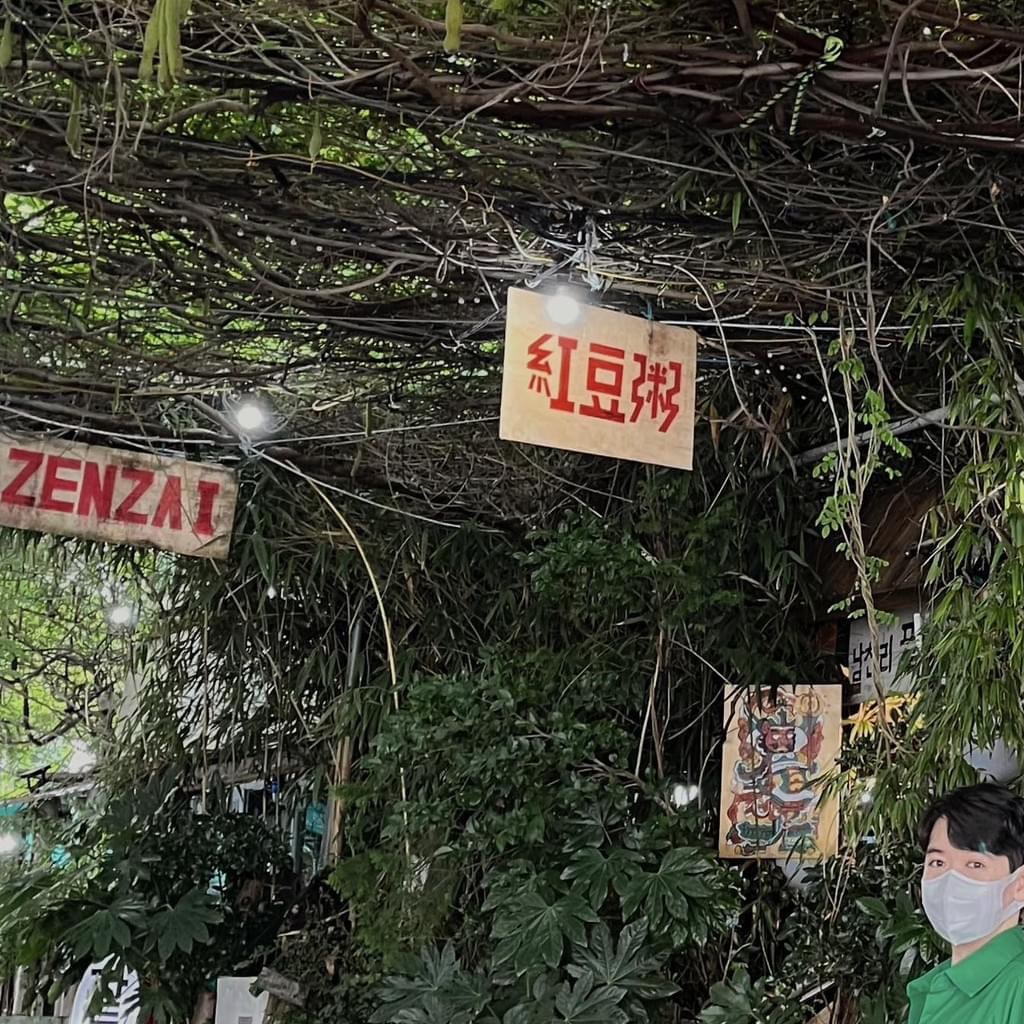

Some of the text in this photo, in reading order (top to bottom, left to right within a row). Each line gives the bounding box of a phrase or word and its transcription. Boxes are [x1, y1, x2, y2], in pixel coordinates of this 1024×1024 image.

[527, 333, 682, 433] 紅豆粥
[0, 447, 220, 537] ZENZAI
